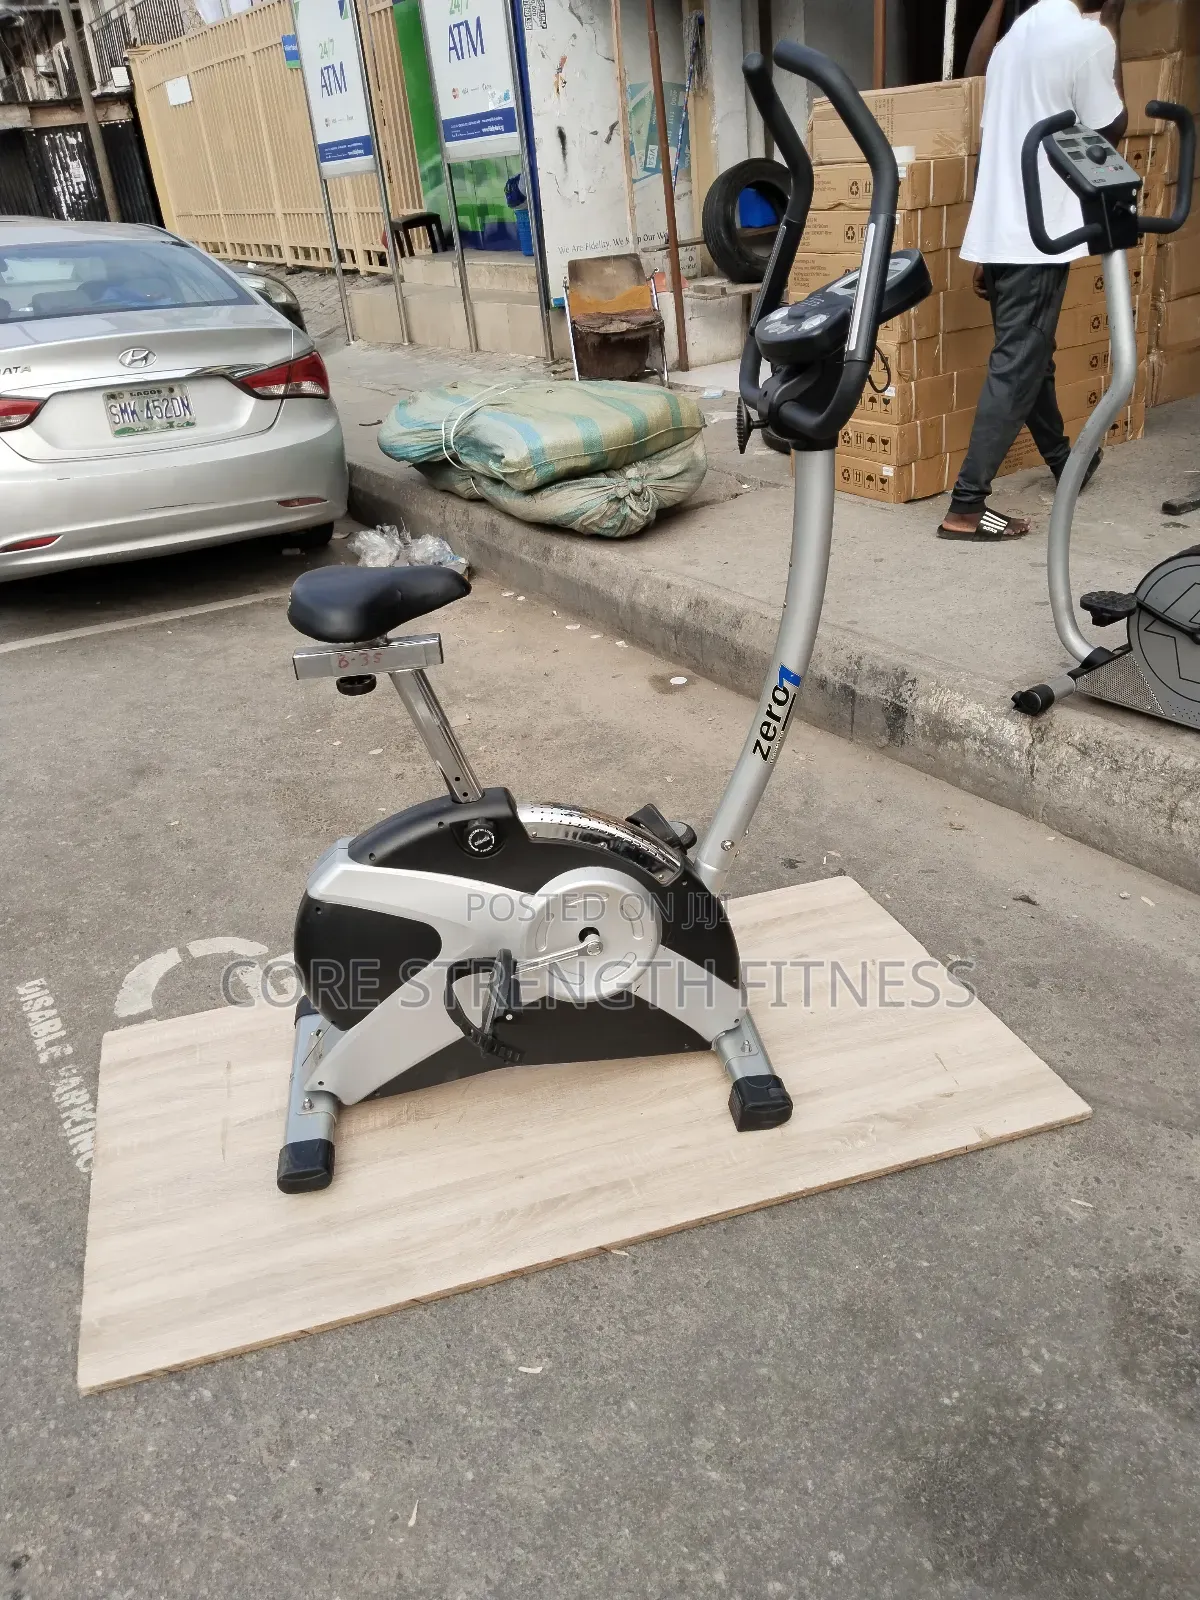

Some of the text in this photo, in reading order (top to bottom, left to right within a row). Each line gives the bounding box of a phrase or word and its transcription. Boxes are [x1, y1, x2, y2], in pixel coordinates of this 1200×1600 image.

[318, 37, 336, 61] 24/7
[448, 15, 485, 63] ATM
[320, 60, 348, 98] ATM
[647, 148, 657, 166] VISA
[558, 245, 570, 255] We
[571, 243, 583, 253] Are
[612, 237, 625, 247] We
[643, 232, 656, 243] Our
[0, 365, 31, 375] ATA
